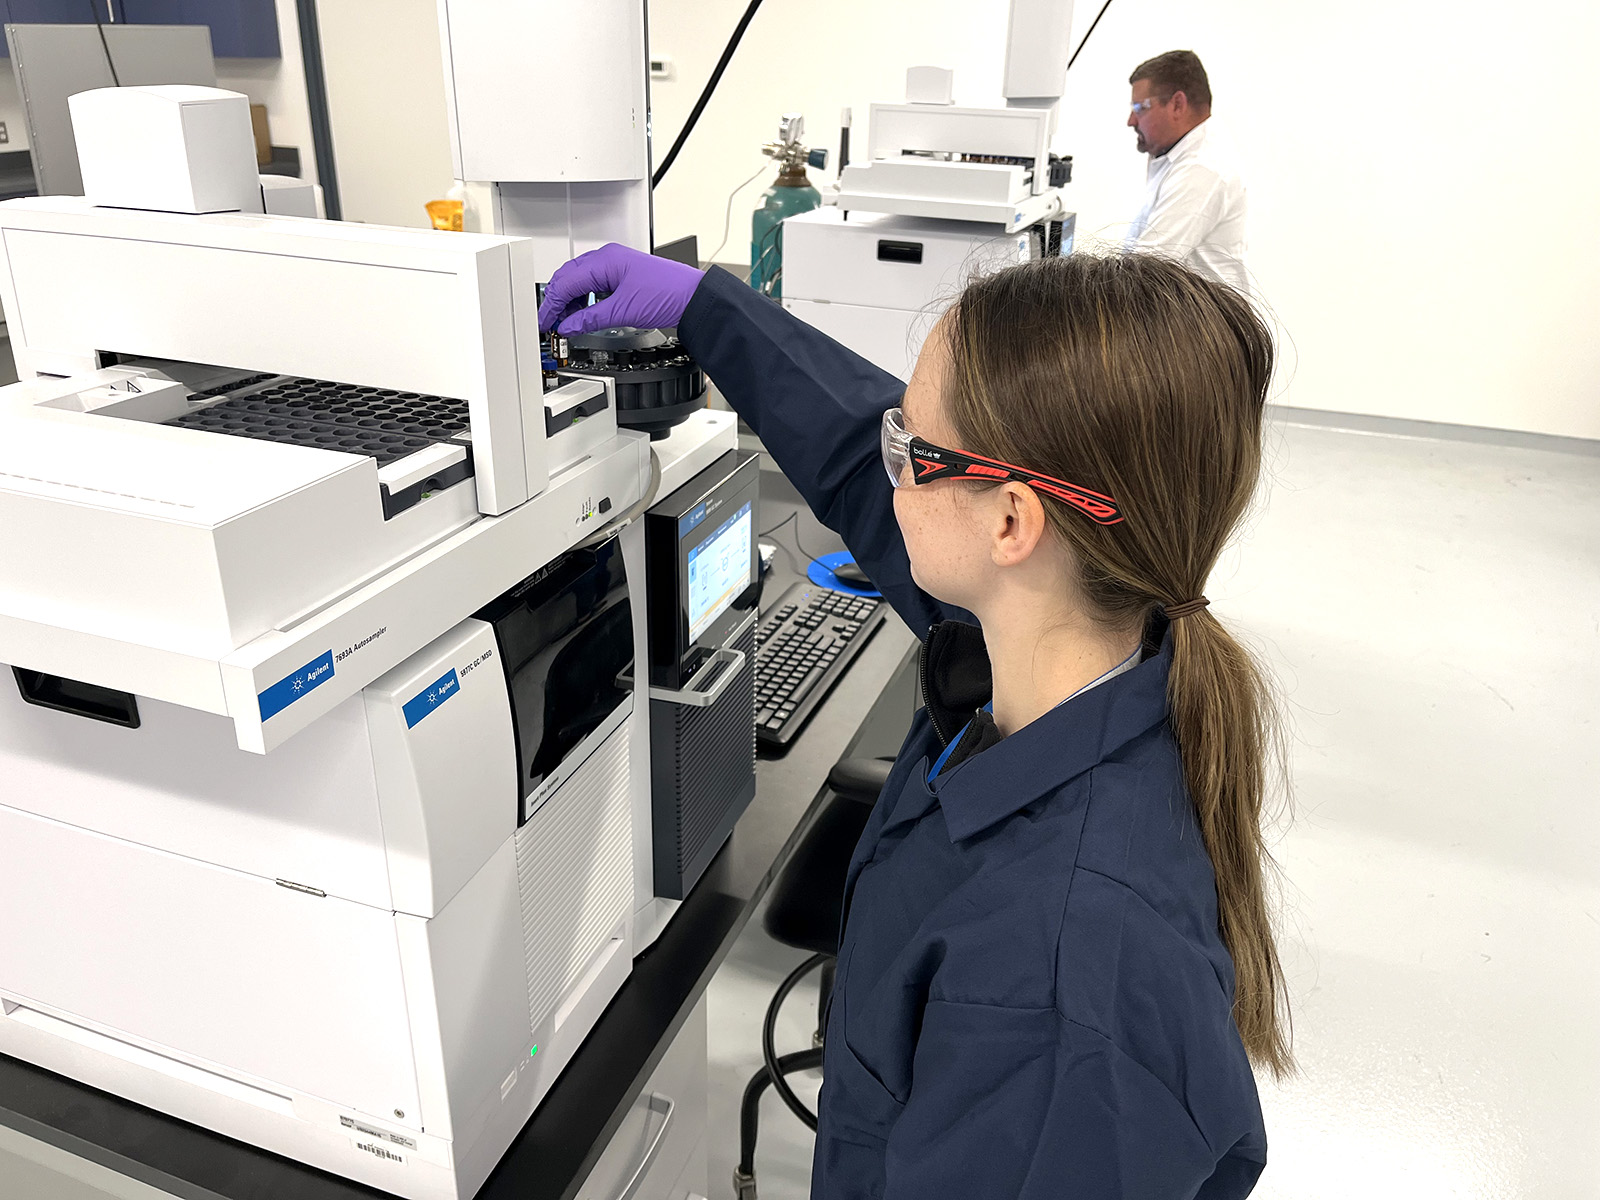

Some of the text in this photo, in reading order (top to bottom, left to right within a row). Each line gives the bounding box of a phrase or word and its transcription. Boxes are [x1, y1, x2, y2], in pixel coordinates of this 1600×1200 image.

[335, 626, 387, 663] 7693A Autosampler
[307, 662, 329, 681] Agilent
[438, 679, 455, 695] Agilent
